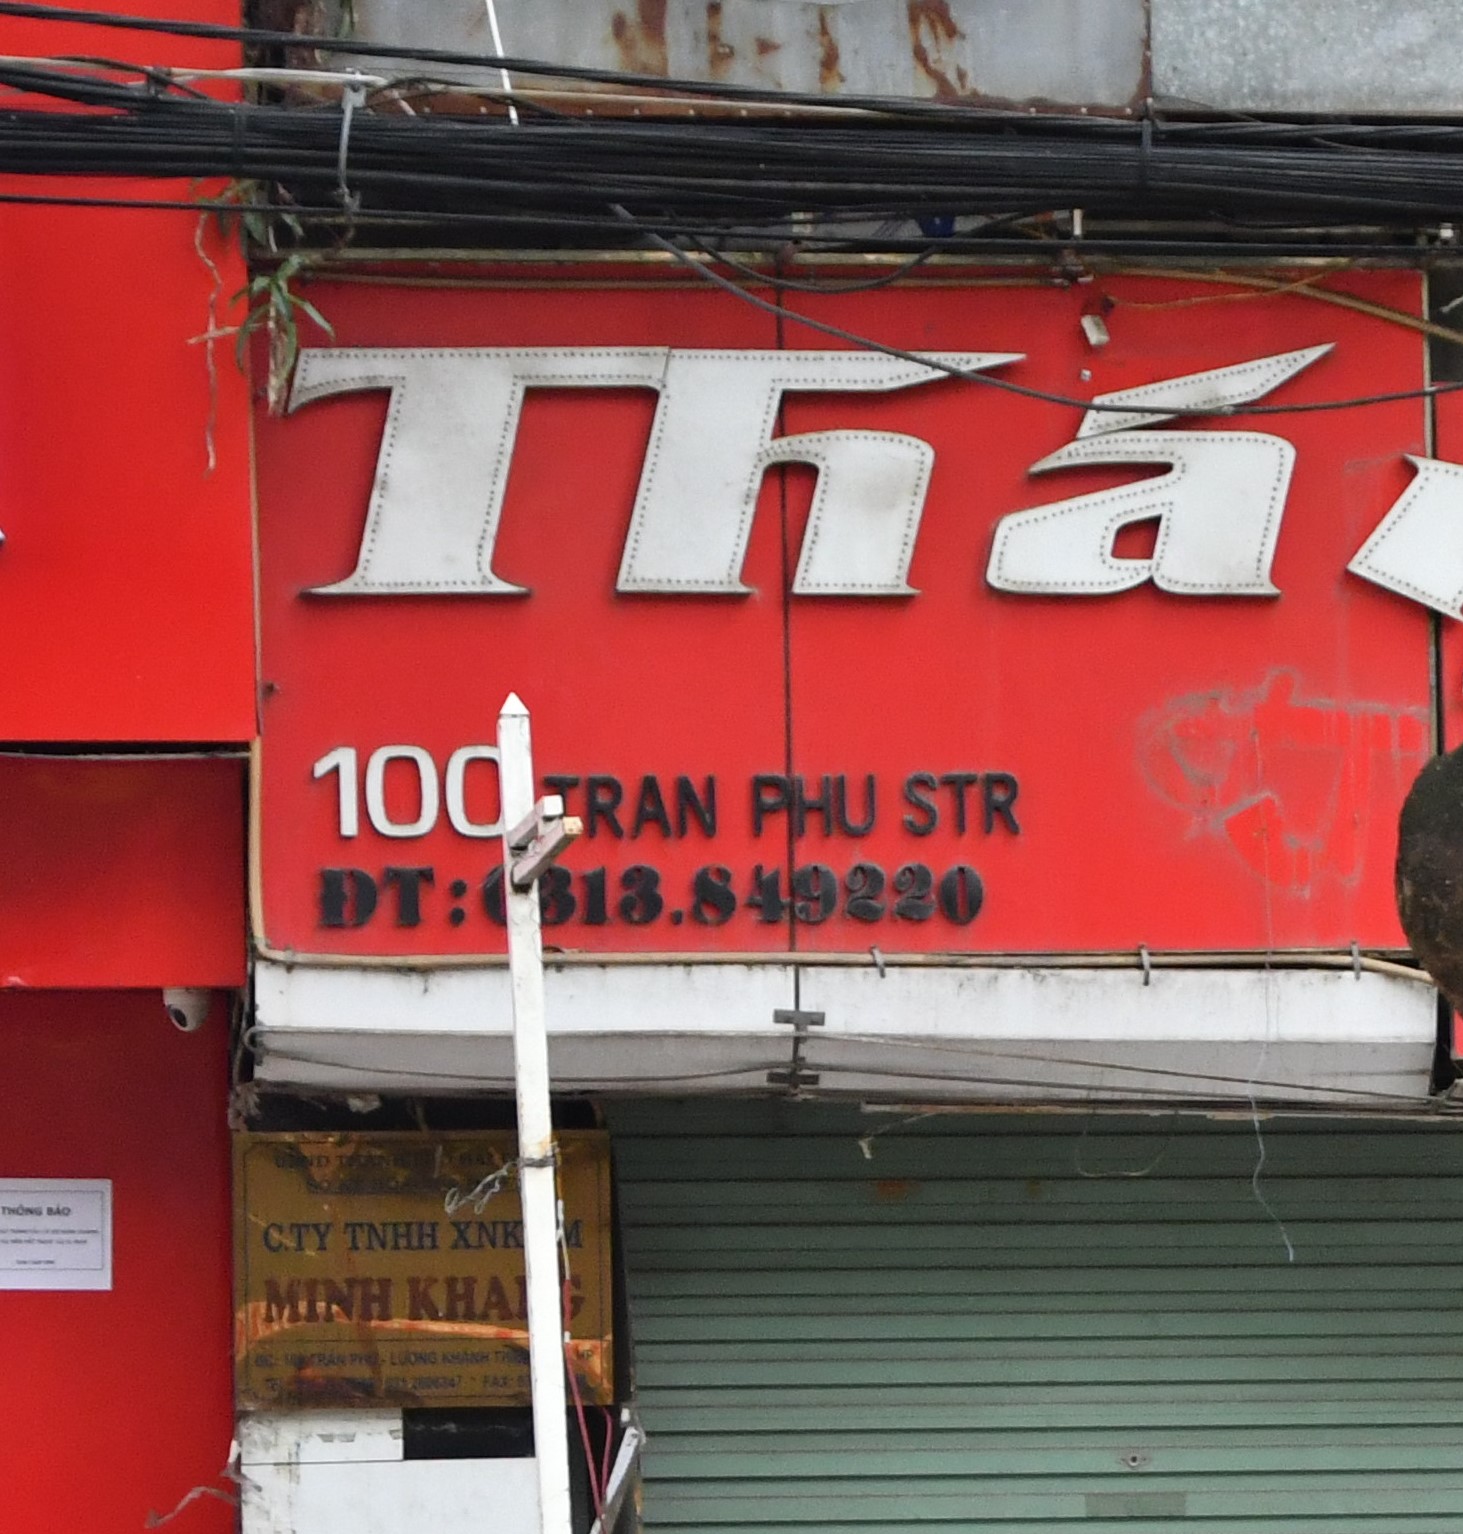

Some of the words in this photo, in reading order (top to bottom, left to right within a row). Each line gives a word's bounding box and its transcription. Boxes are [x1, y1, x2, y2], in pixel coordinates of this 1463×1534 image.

[311, 744, 506, 839] 100
[752, 772, 877, 838] PHU
[903, 771, 1022, 836] STR
[343, 1221, 439, 1250] TNHH
[264, 1276, 392, 1323] MINH
